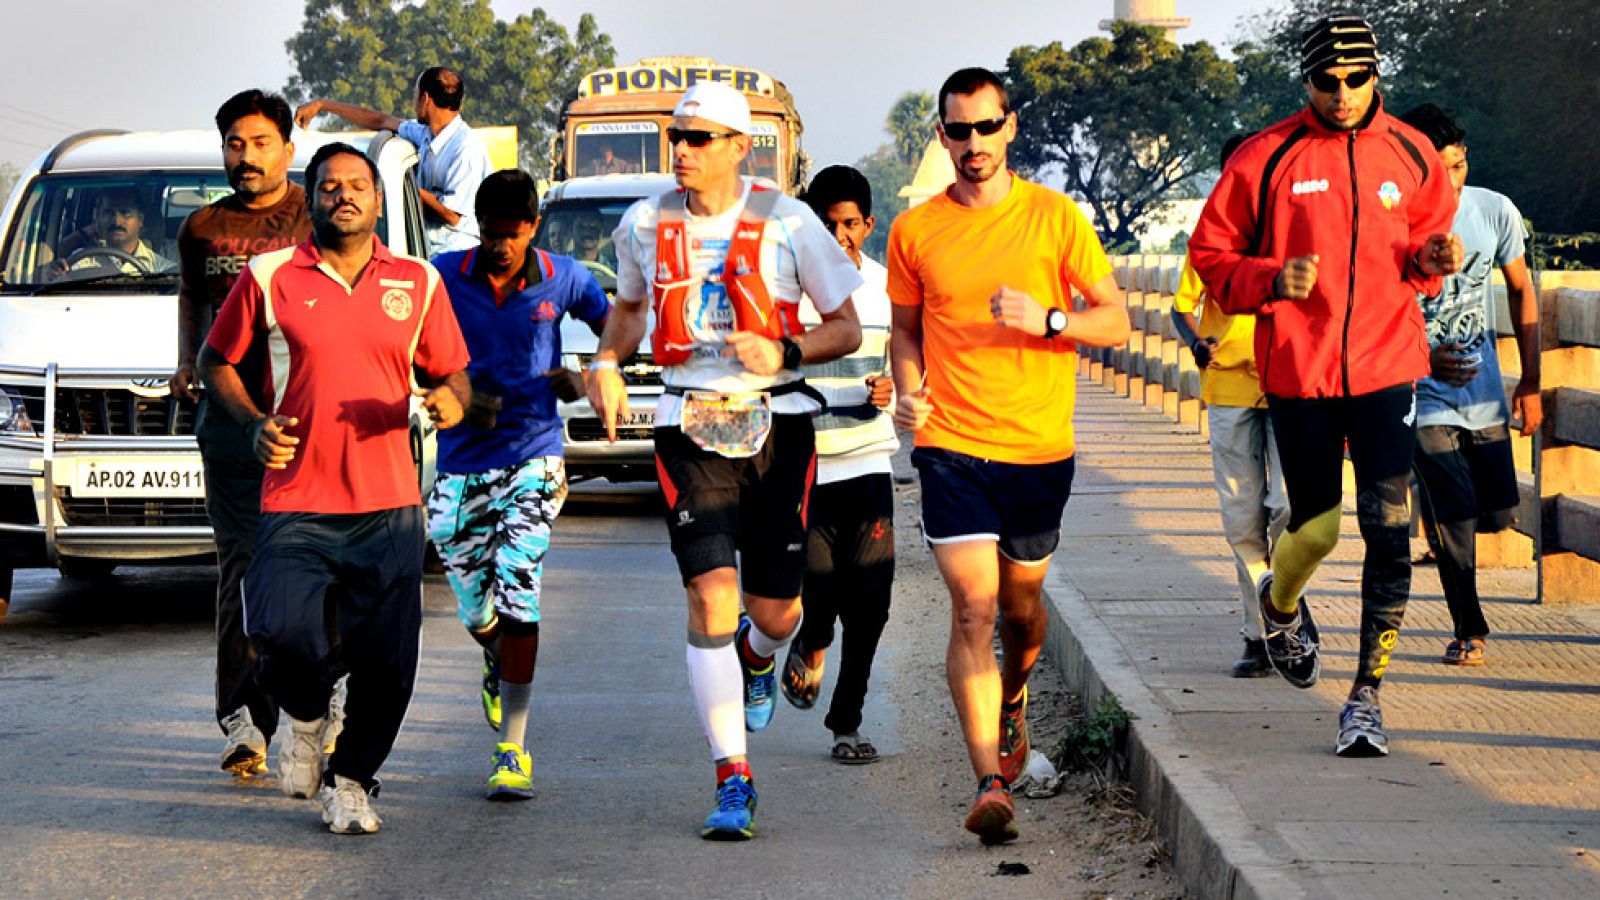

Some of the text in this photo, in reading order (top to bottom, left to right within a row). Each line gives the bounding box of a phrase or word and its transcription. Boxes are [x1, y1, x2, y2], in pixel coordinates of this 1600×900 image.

[591, 67, 760, 94] PIONEER
[753, 136, 775, 148] 512
[205, 255, 250, 275] BRE
[87, 470, 135, 488] AP.02
